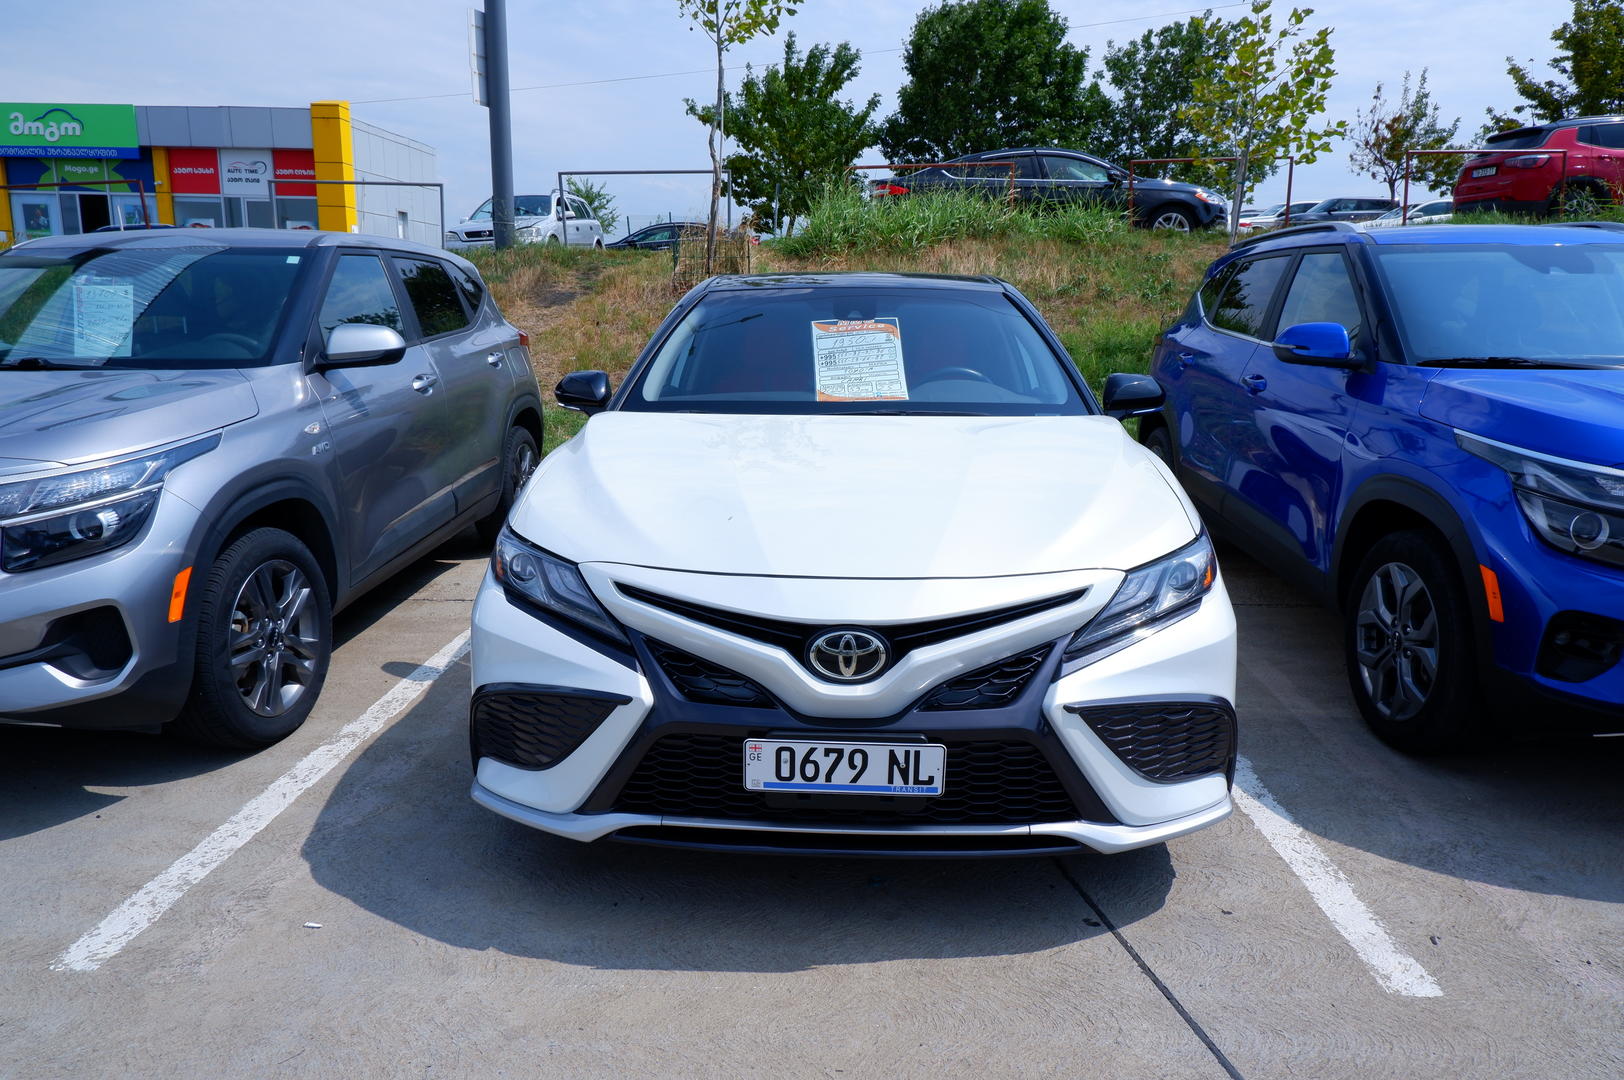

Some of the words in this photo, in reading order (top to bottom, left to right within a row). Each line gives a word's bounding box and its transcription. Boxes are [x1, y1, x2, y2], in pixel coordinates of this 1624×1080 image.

[9, 112, 81, 142] მოგო
[64, 164, 99, 174] Mogo.ge
[749, 752, 763, 762] GE
[775, 746, 869, 784] 0679
[887, 749, 935, 786] NL
[890, 785, 927, 793] TRANSIT
